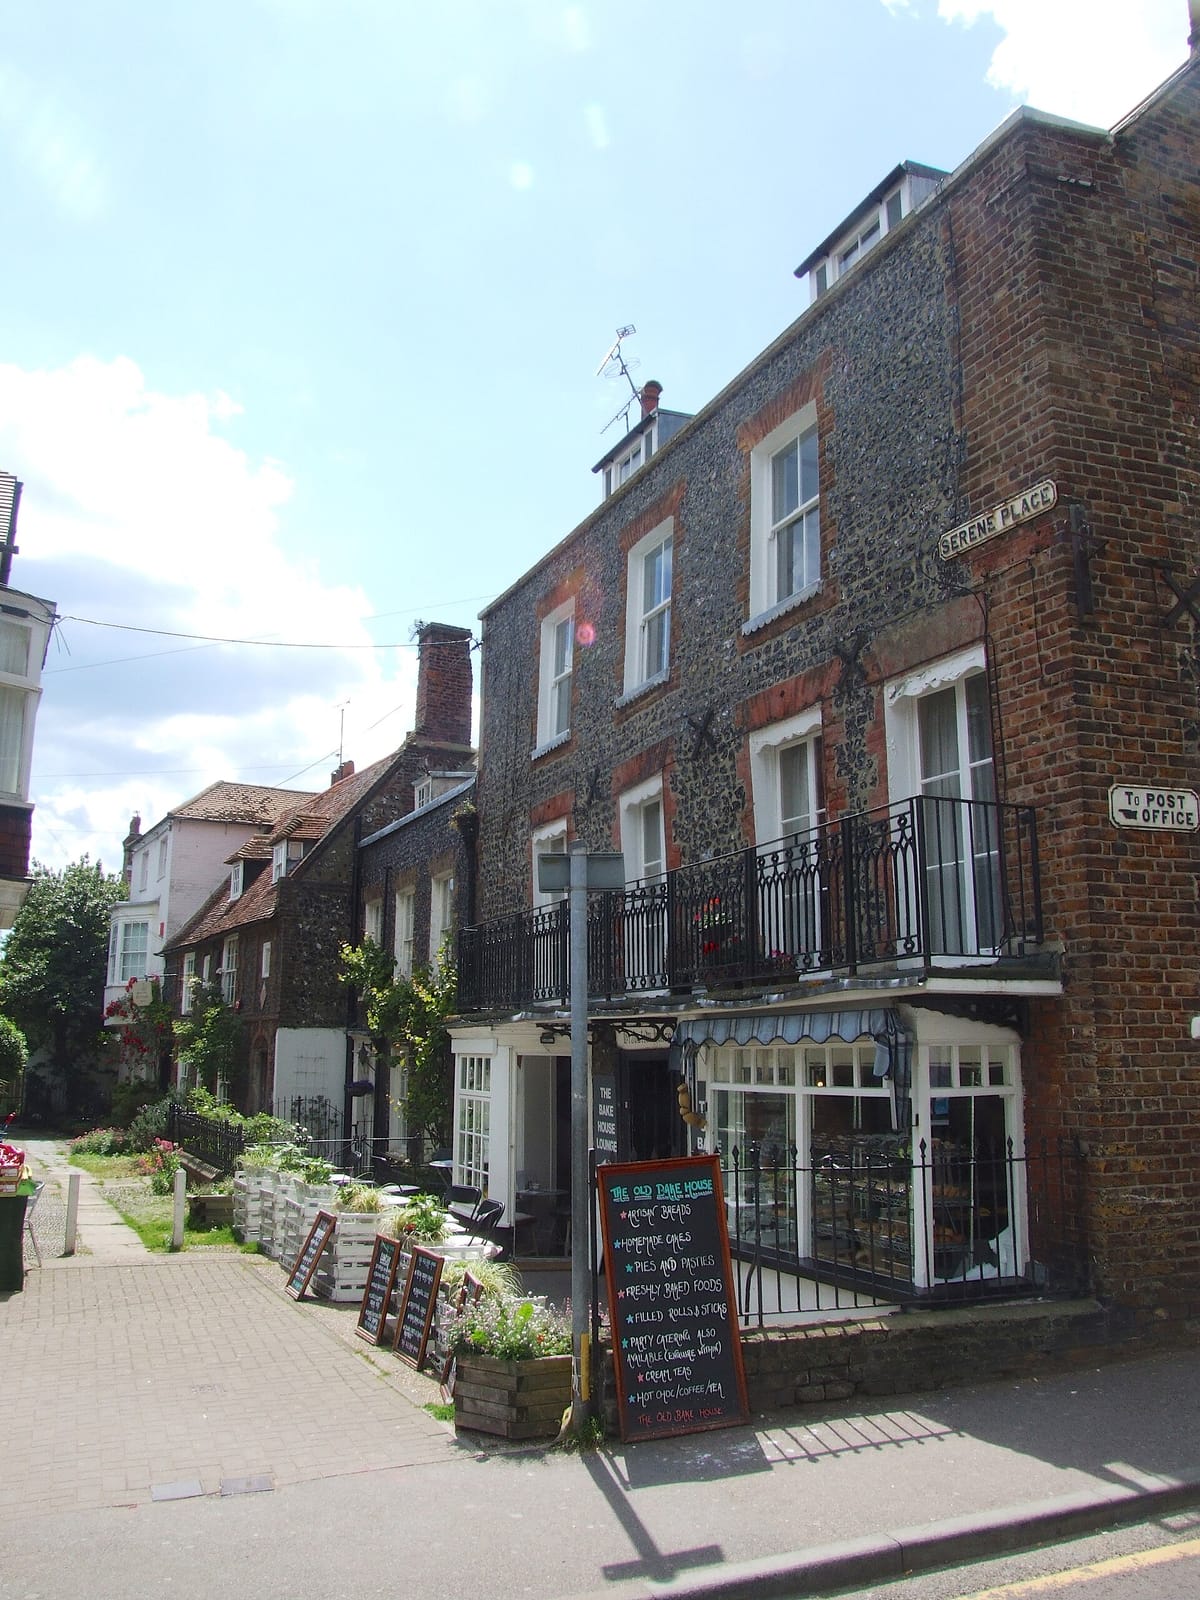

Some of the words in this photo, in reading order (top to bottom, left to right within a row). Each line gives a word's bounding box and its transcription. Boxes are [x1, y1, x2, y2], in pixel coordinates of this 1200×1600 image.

[941, 515, 996, 555] SERENE
[1000, 486, 1052, 527] PLACE
[1146, 793, 1185, 809] POST
[1142, 809, 1194, 826] OFFICE
[600, 1087, 612, 1099] THE
[598, 1103, 614, 1117] BAKE
[597, 1121, 616, 1134] HOUSE
[596, 1137, 618, 1152] LOUNGE
[610, 1186, 630, 1202] THE
[633, 1185, 653, 1196] OLD
[656, 1183, 682, 1201] BAKE
[684, 1179, 713, 1199] HOUSE
[627, 1205, 658, 1228] ARTISAN
[660, 1204, 692, 1224] BREADS
[621, 1234, 664, 1256] HOMEMADE
[666, 1231, 692, 1254] CAKES
[634, 1260, 657, 1273] PIES
[660, 1256, 677, 1277] AND
[681, 1254, 715, 1275] PASTIES
[626, 1284, 661, 1301] FRESHLY
[663, 1280, 690, 1301] BAKED
[693, 1278, 723, 1292] FOODS
[635, 1310, 664, 1323] FILLED
[668, 1305, 693, 1322] ROLLS
[701, 1302, 728, 1320] STICKS
[630, 1334, 654, 1353] PARTY
[656, 1329, 691, 1349] CATERING
[697, 1328, 716, 1346] ALSO
[626, 1351, 664, 1369] AVAILABLE
[645, 1369, 673, 1383] CREAM
[673, 1366, 692, 1381] TEAS
[637, 1391, 654, 1408] HOT
[638, 1414, 654, 1426] THE
[657, 1411, 672, 1423] OLD
[699, 1407, 724, 1420] HOUSE
